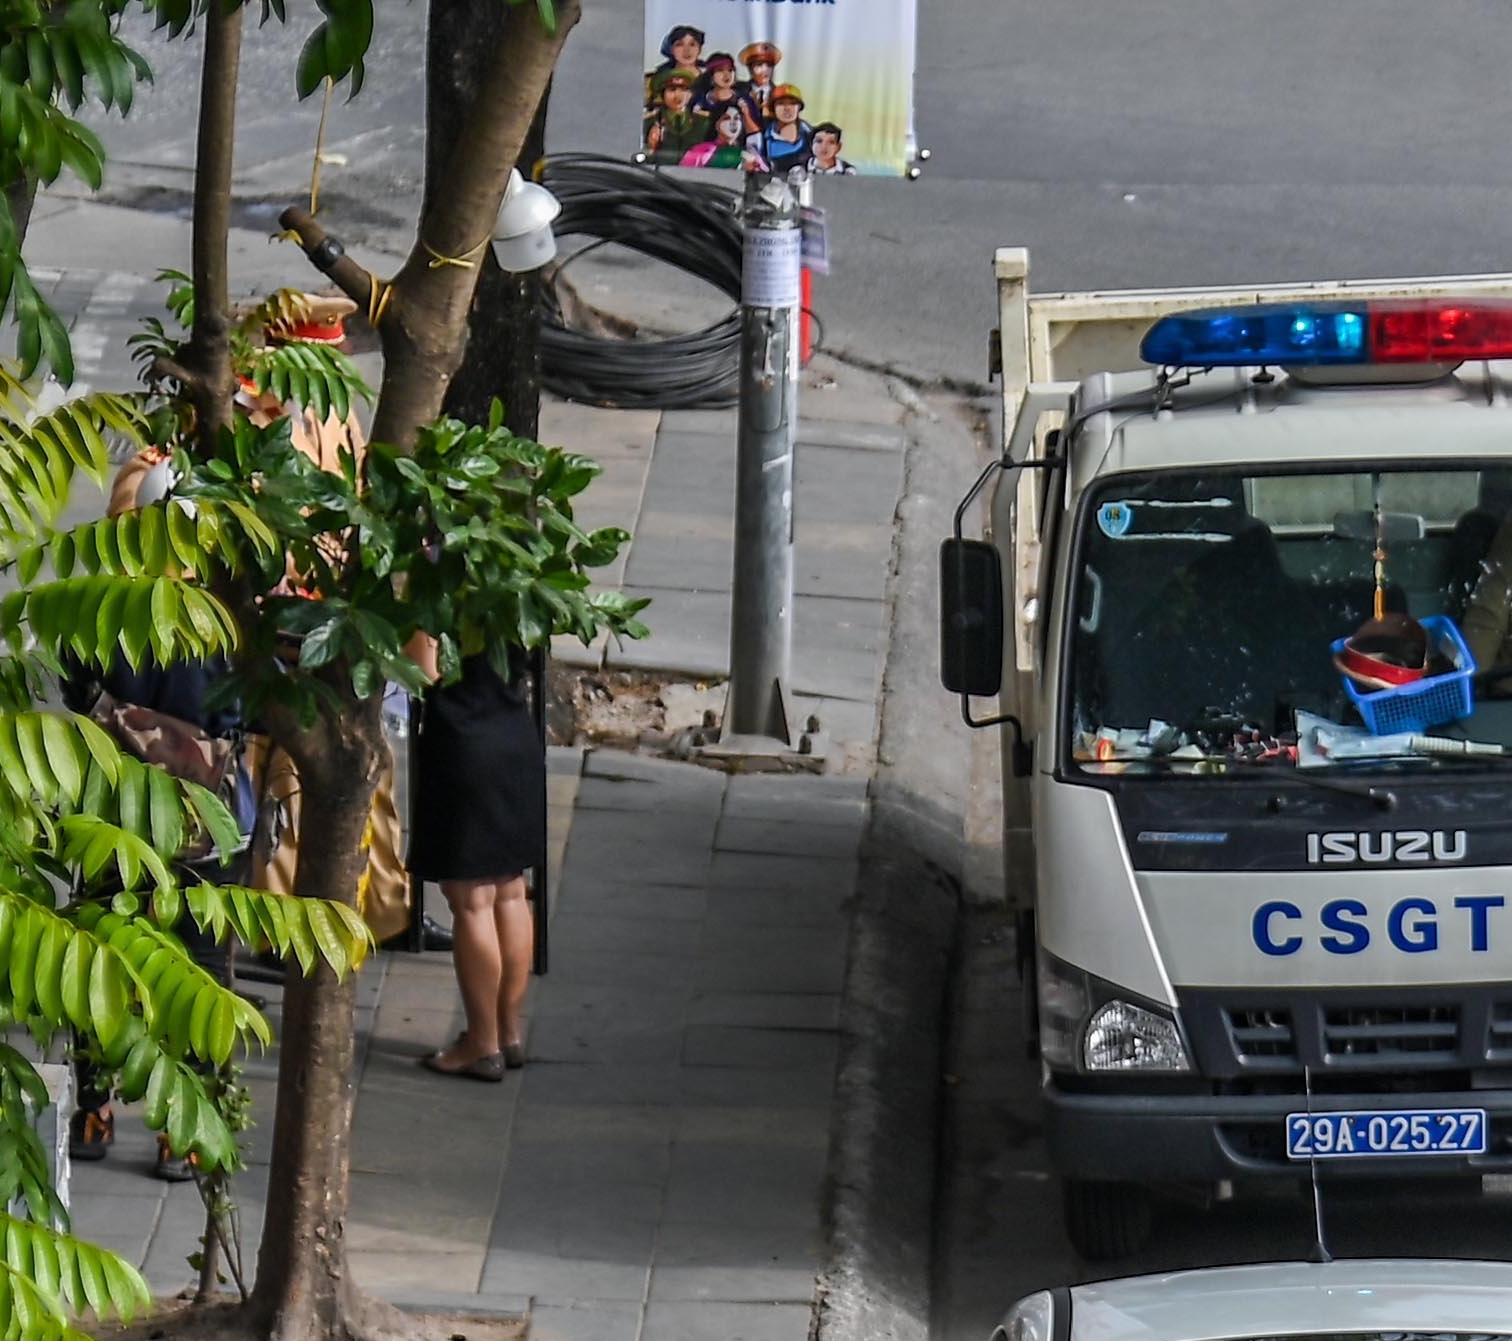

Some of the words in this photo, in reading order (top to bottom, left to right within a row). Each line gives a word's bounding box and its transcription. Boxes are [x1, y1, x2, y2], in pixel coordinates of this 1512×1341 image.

[1306, 830, 1467, 864] ISUZU
[1251, 894, 1505, 957] CSGT
[1292, 1114, 1480, 1153] 29A-025.27
